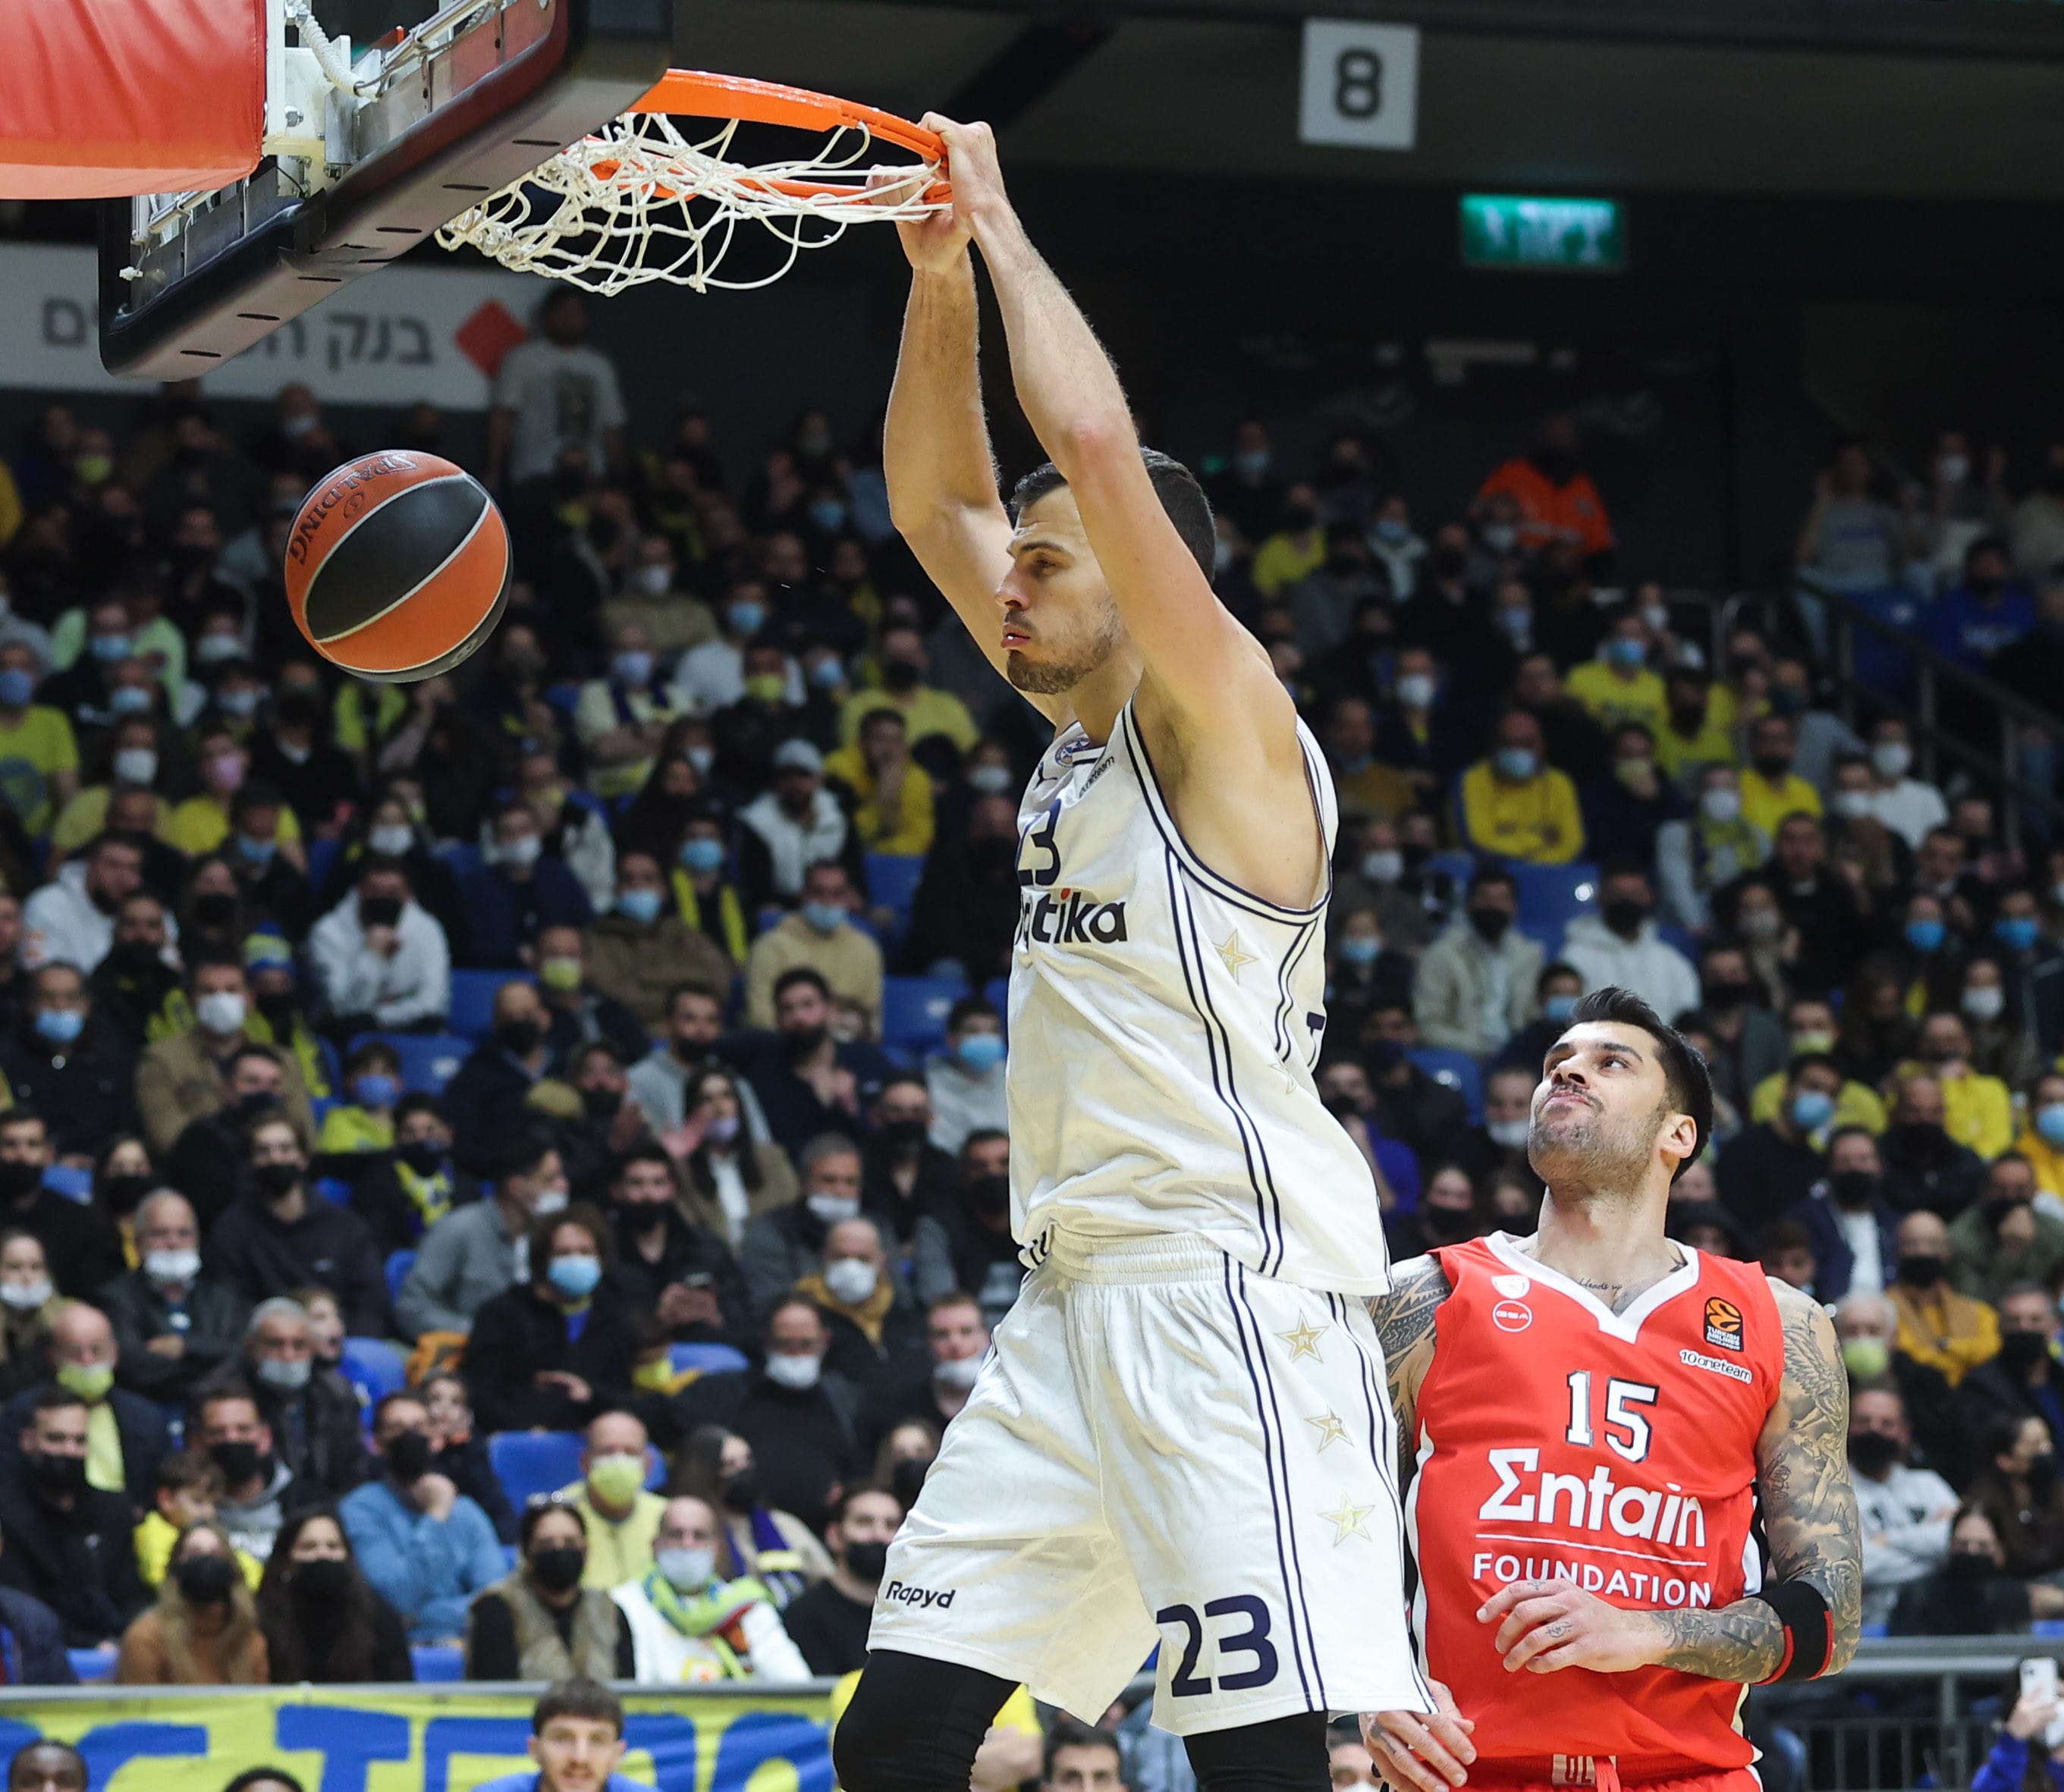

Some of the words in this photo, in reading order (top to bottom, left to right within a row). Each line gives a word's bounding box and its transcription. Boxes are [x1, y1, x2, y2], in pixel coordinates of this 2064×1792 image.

[1335, 48, 1382, 121] 8
[327, 312, 436, 375] בנק
[289, 453, 418, 565] SPALDING
[1566, 1370, 1659, 1464] 15
[885, 1580, 956, 1608] Rapyd
[1473, 1552, 1711, 1607] FOUNDATION
[1156, 1594, 1279, 1697] 23
